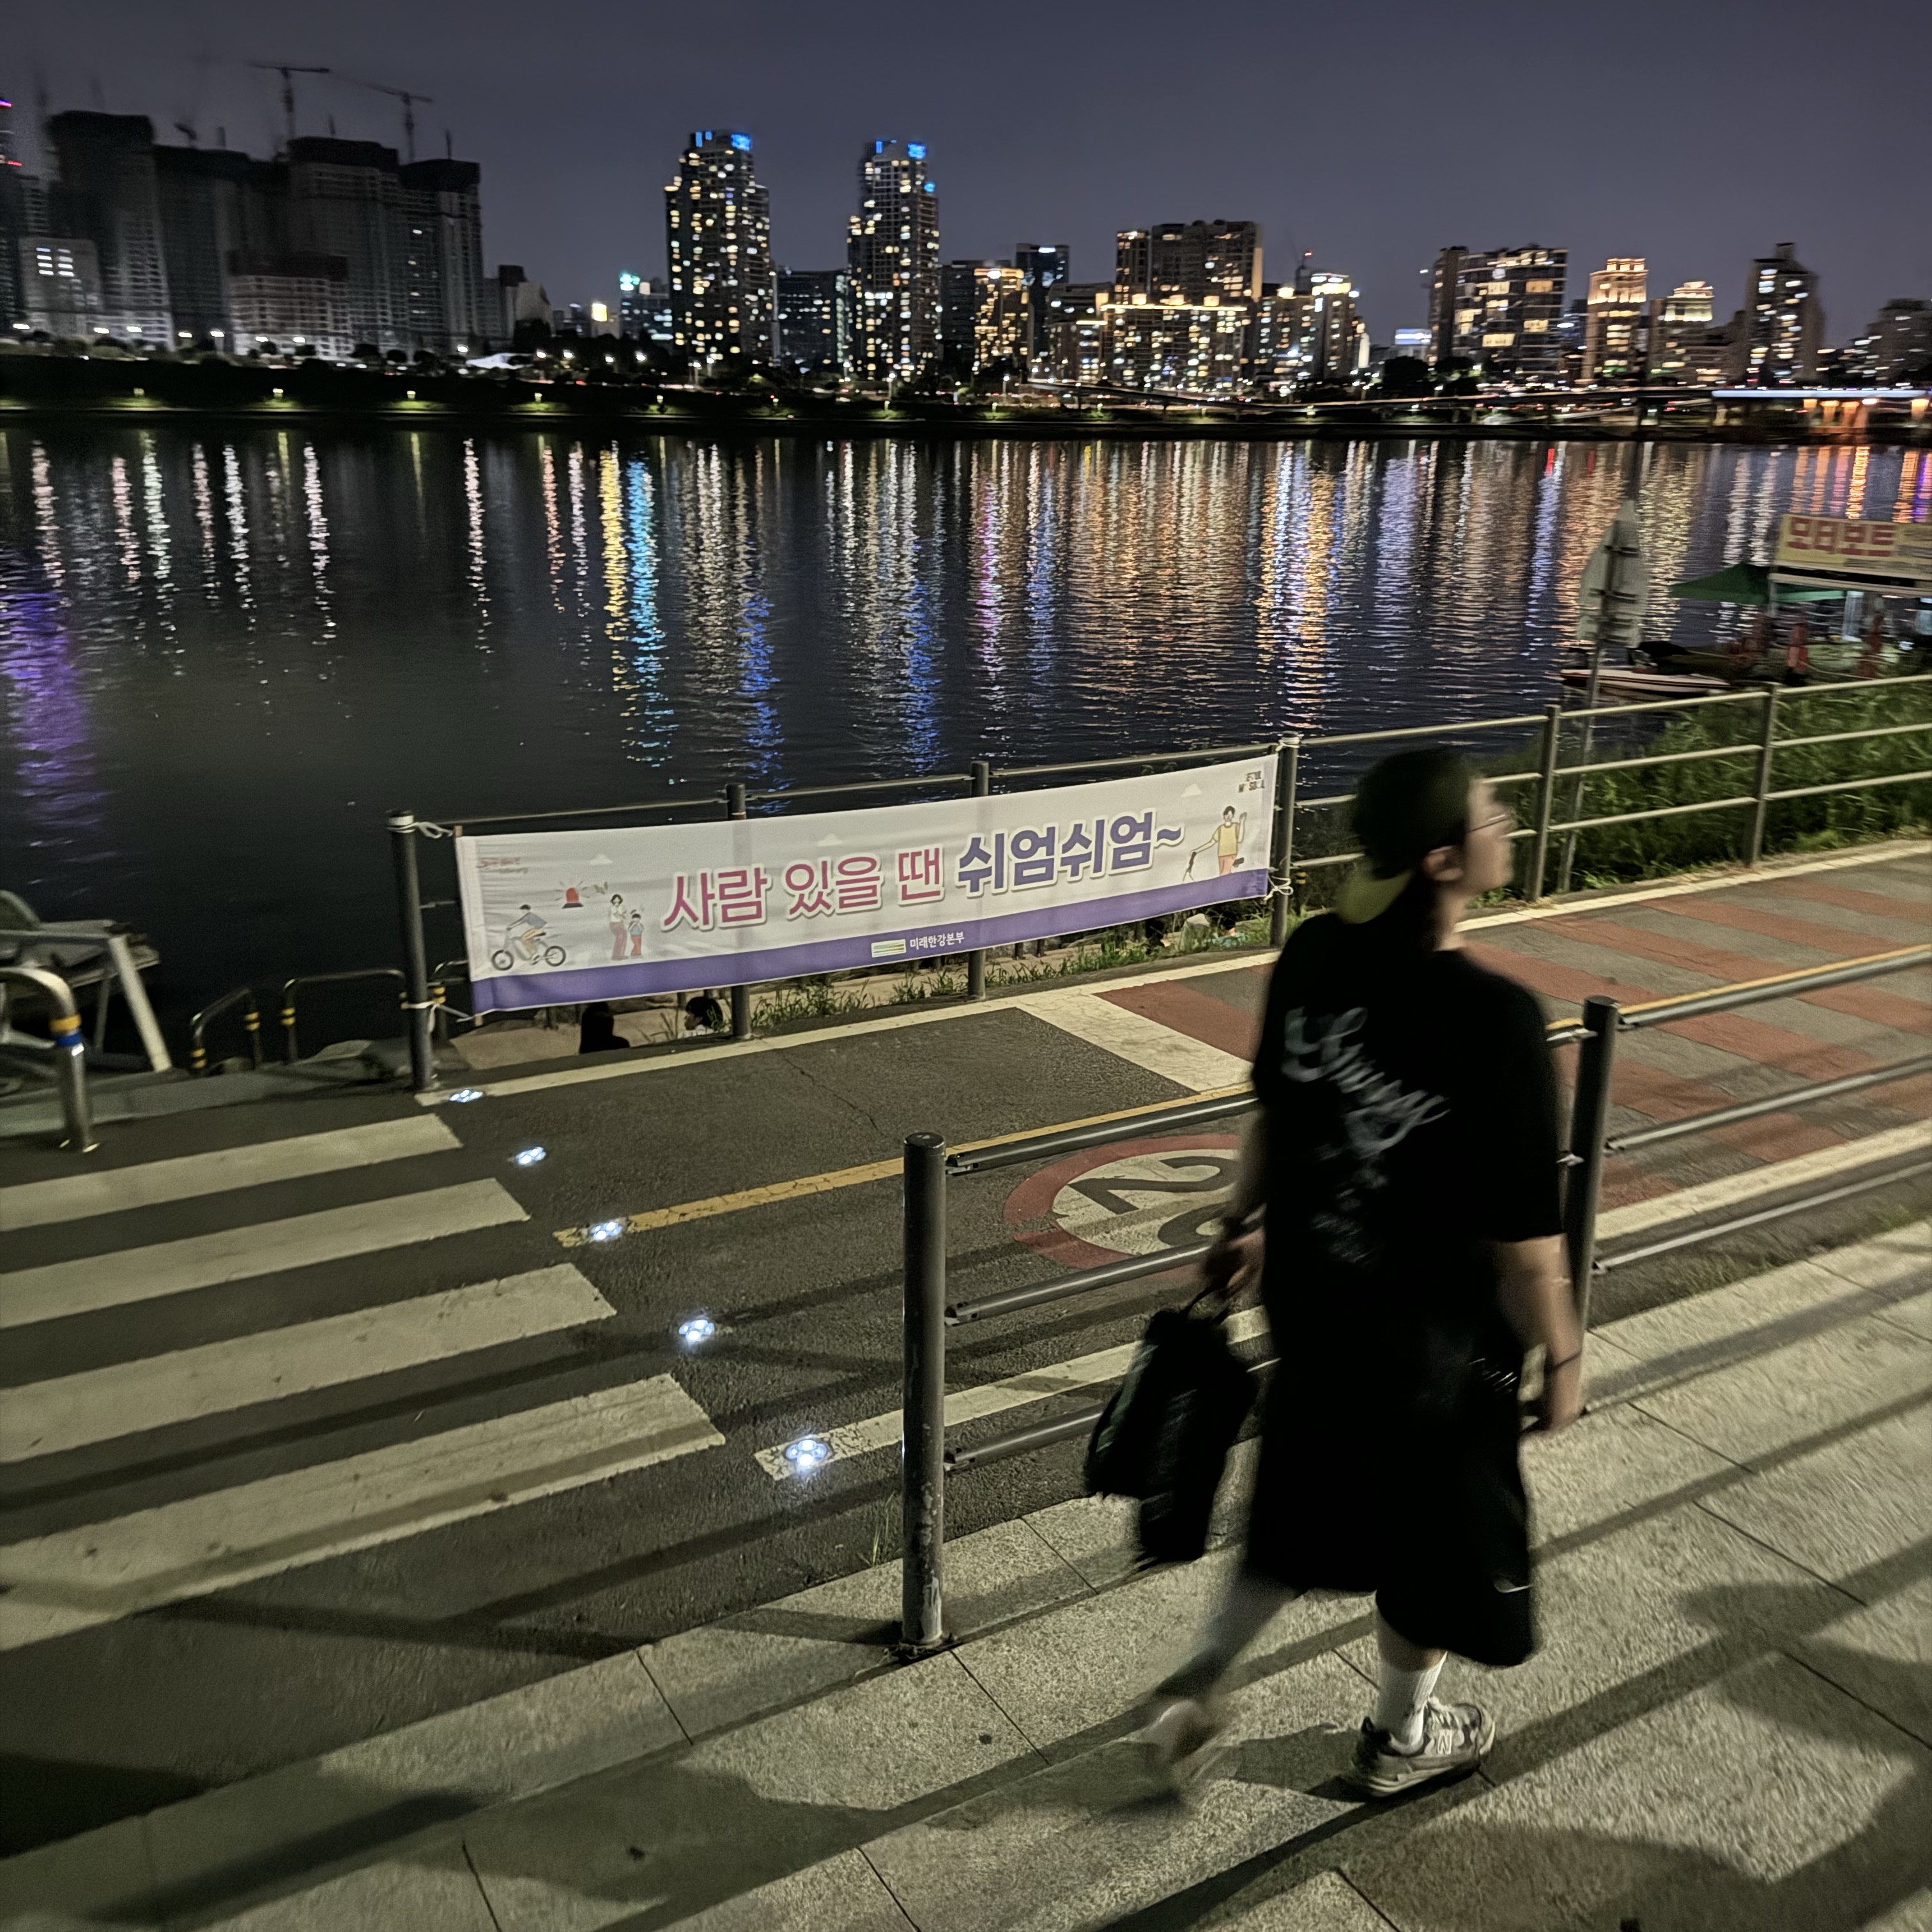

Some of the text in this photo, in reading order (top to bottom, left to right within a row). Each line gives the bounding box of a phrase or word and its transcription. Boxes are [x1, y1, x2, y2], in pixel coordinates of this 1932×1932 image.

[664, 811, 1182, 926] 사람 있을 땐 쉬엄쉬엄~
[909, 931, 965, 950] 미래한강본부
